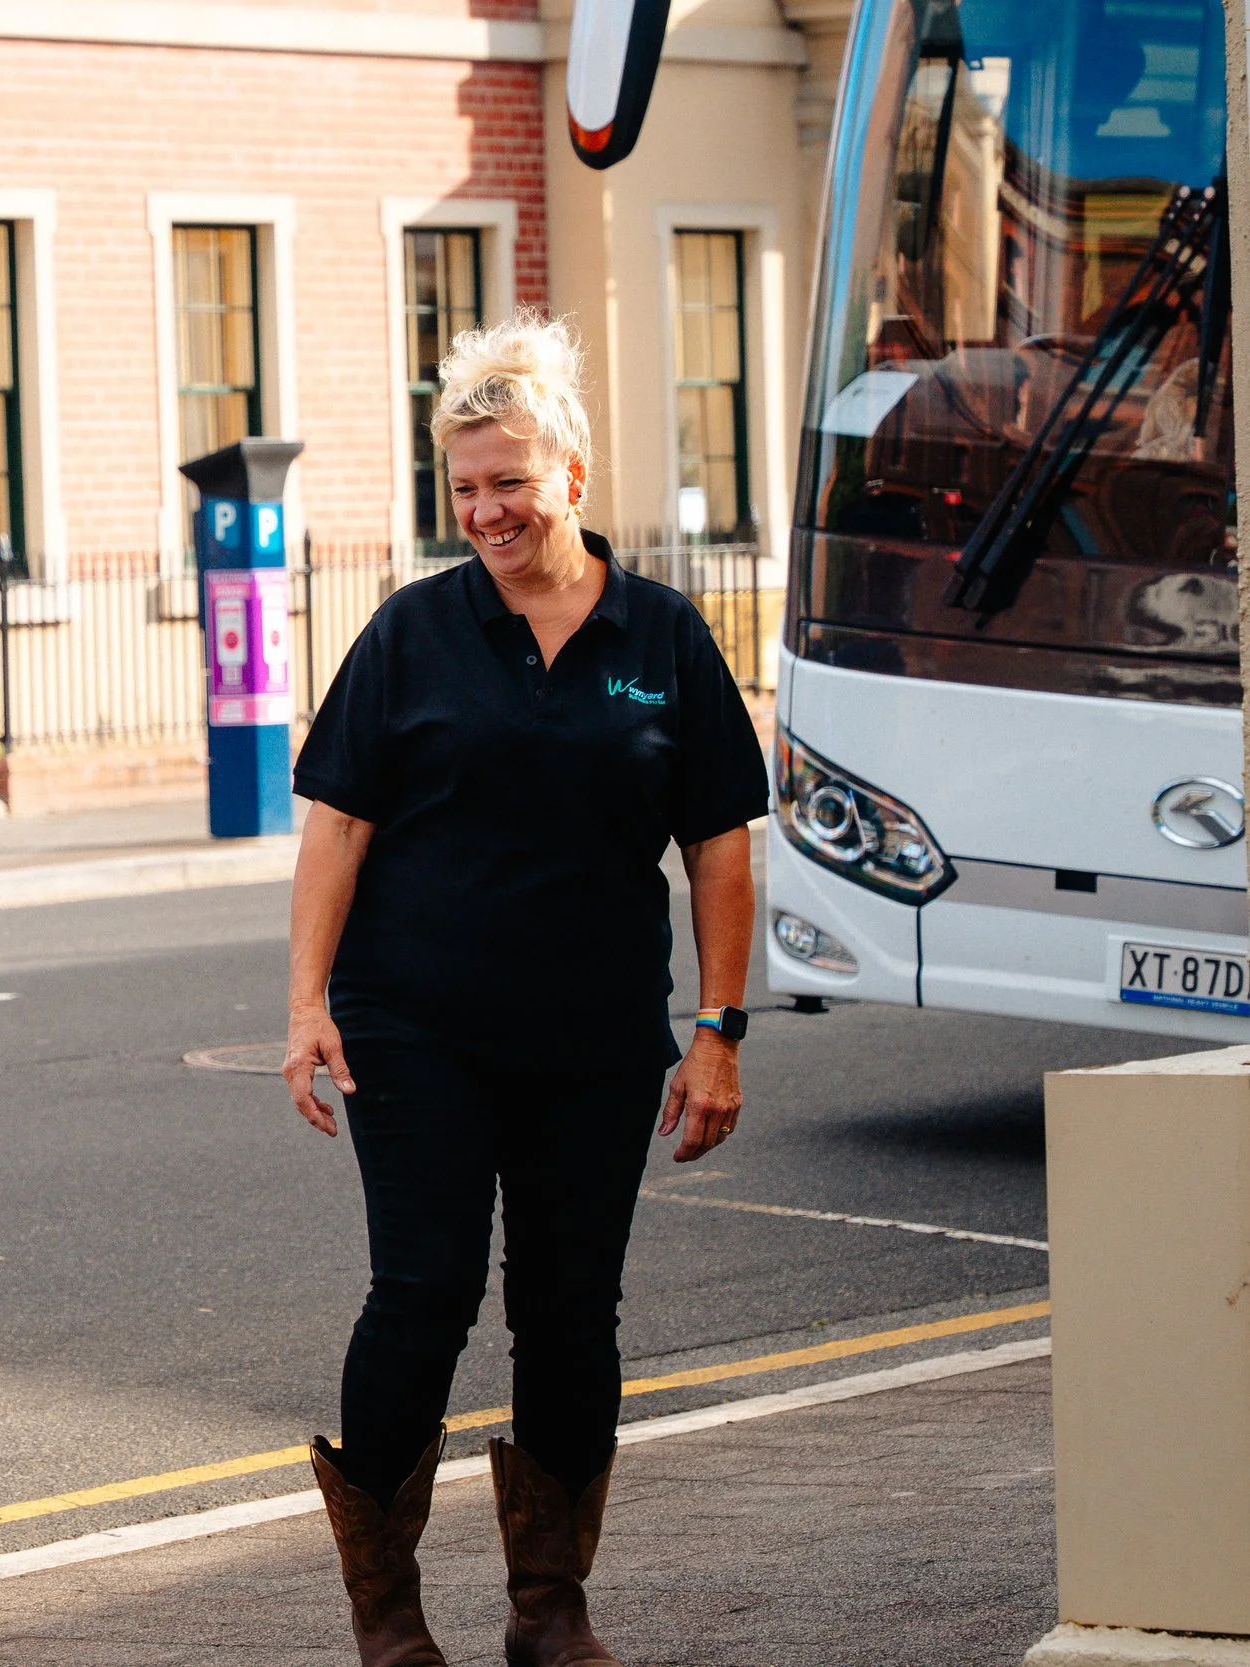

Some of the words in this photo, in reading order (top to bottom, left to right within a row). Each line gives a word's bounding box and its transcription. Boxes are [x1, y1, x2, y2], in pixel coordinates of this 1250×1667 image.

[215, 502, 237, 541] P
[258, 508, 278, 548] P
[629, 686, 664, 700] wynyard
